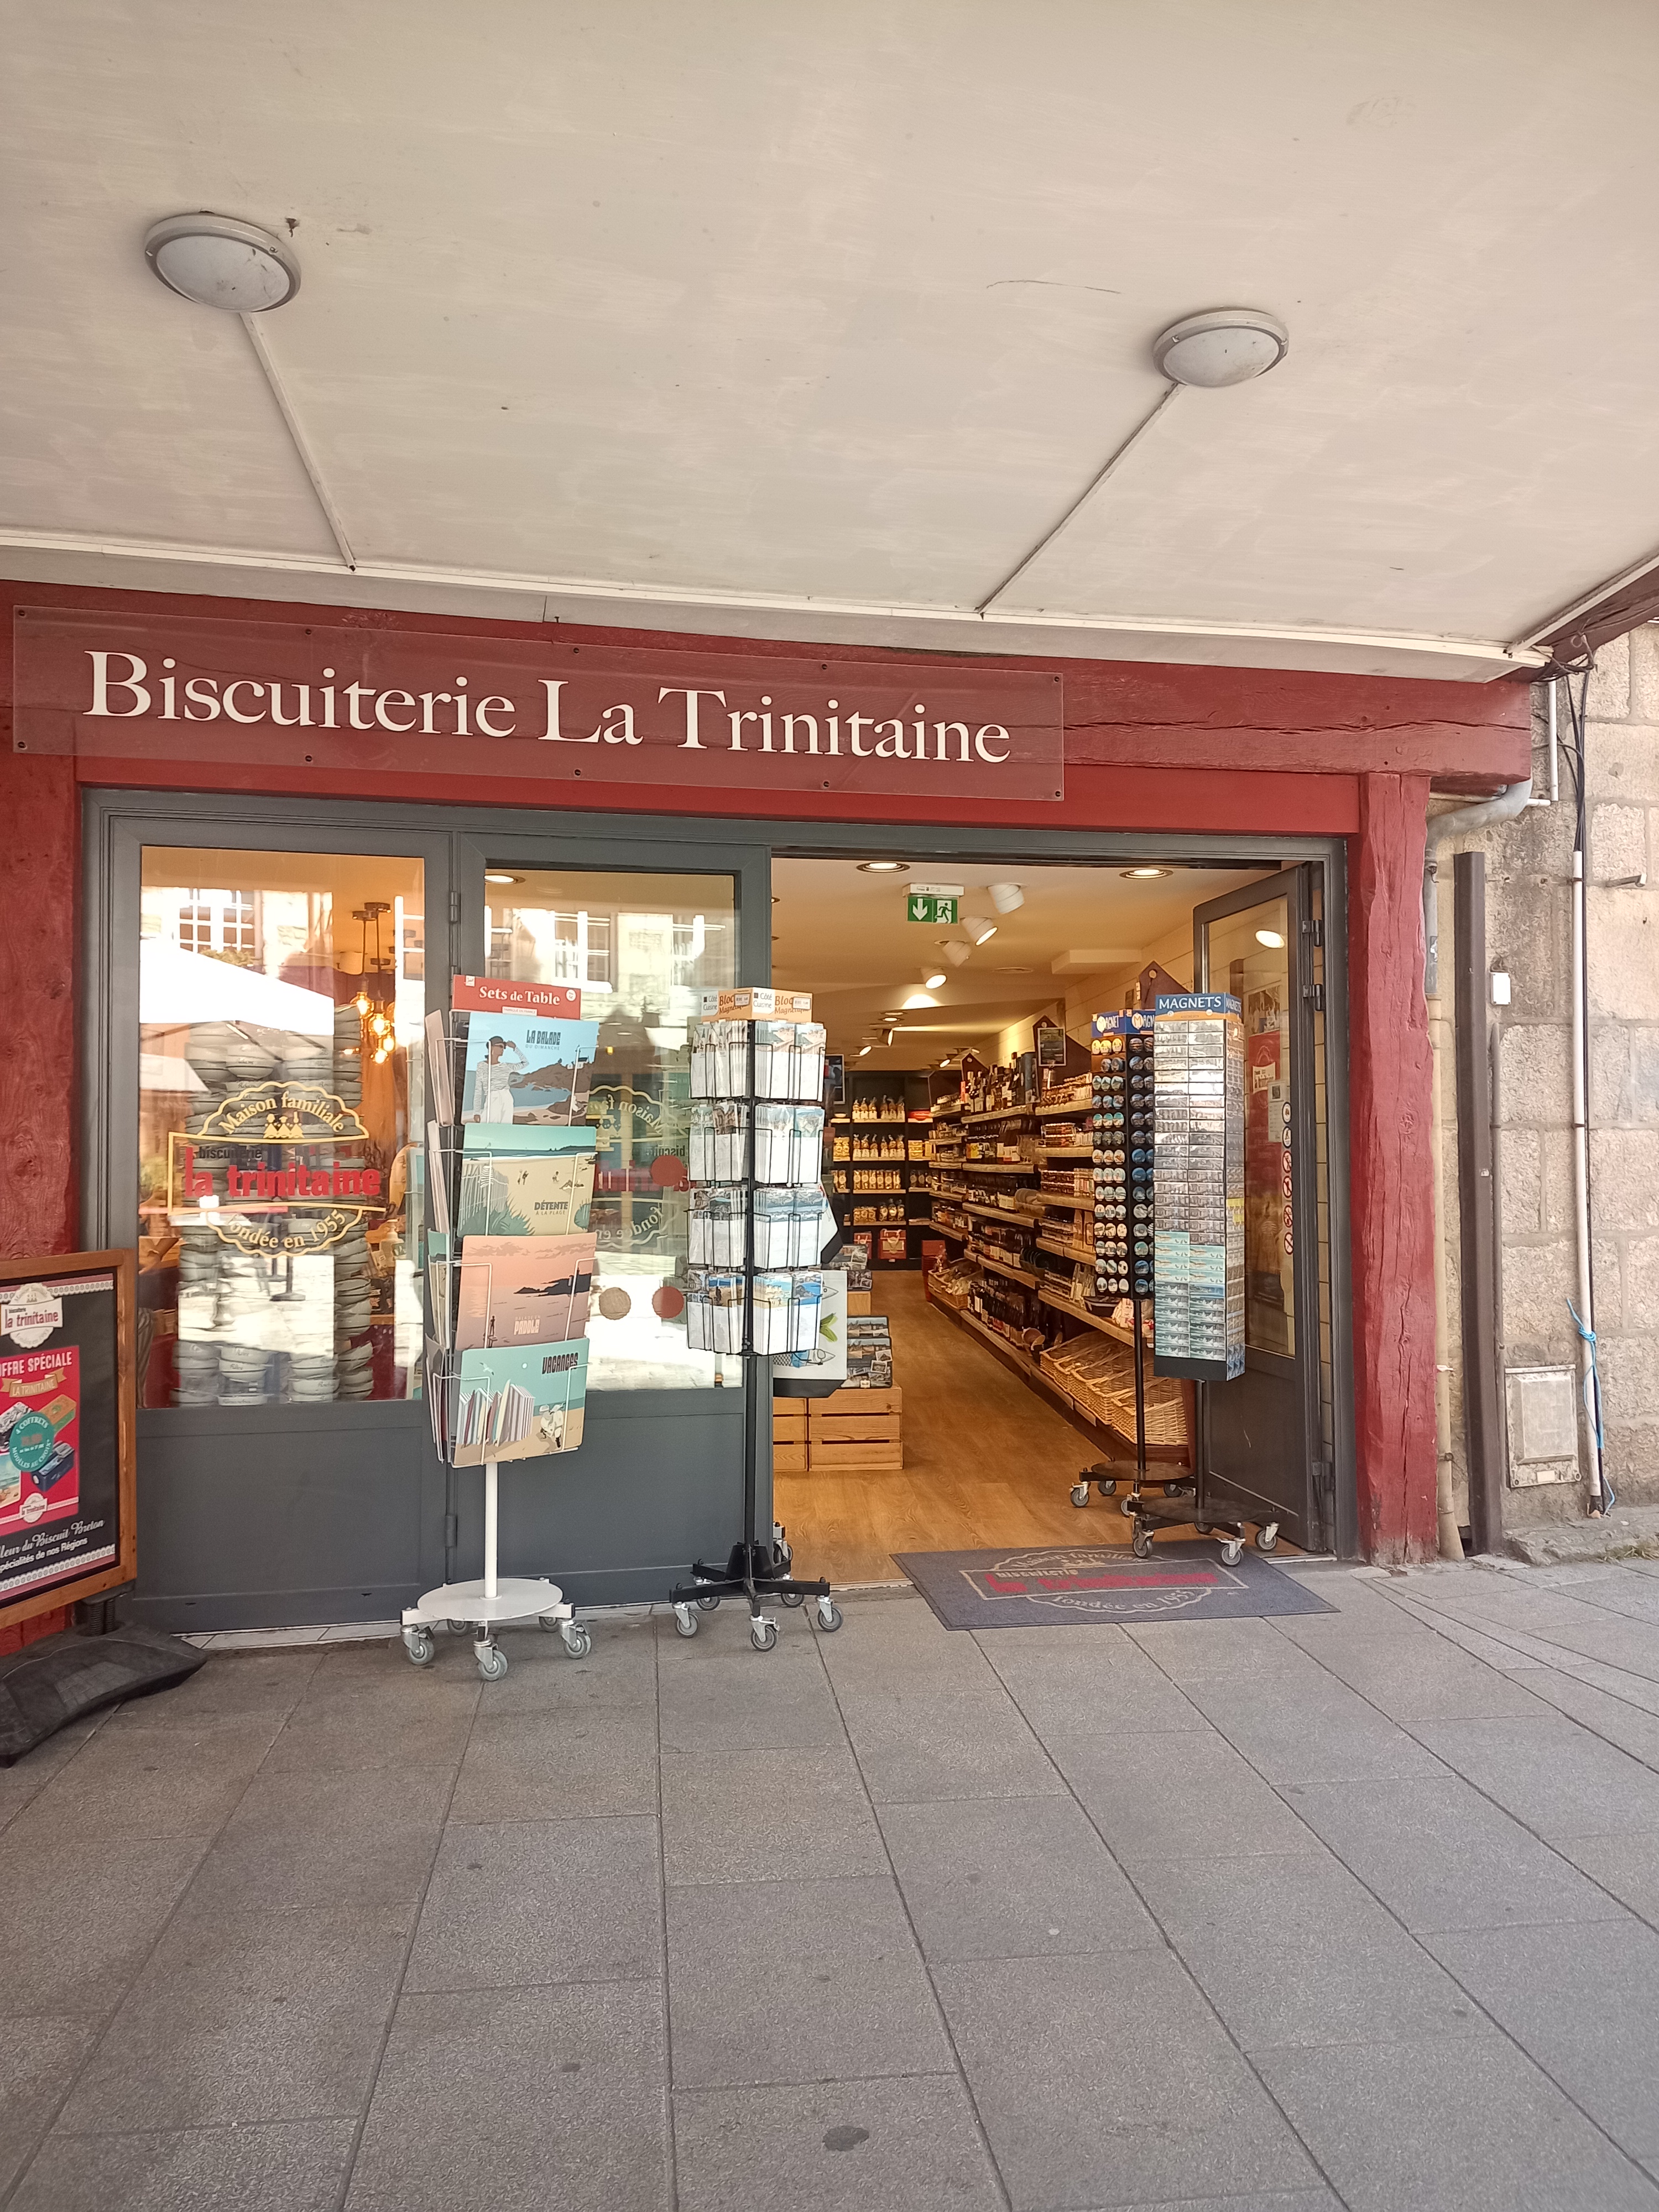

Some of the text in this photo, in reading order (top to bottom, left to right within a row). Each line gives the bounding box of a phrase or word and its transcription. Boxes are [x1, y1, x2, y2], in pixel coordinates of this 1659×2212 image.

[83, 650, 1011, 763] Biscuiterie La Trinitaine
[479, 986, 508, 1000] Sets
[510, 991, 523, 1001] de
[525, 990, 560, 1005] Table
[753, 1000, 772, 1009] Cuisine
[1159, 996, 1222, 1009] MAGNETS
[526, 1029, 561, 1046] LA BALADE
[218, 1091, 344, 1134] Maison familiale
[185, 1146, 382, 1197] la trinitaine
[534, 1199, 568, 1211] DÉTENTE
[226, 1209, 346, 1248] fondée en 1955
[5, 1309, 59, 1328] la trinitaine
[513, 1319, 540, 1335] PADDLE
[27, 1352, 72, 1372] SPÉCIALE
[12, 1379, 55, 1396] LA TRINITAINE
[19, 1416, 49, 1428] COFFRETS
[32, 1528, 70, 1547] Biscuit
[71, 1520, 105, 1535] Breton
[0, 1537, 88, 1573] pécialités de nos Régions
